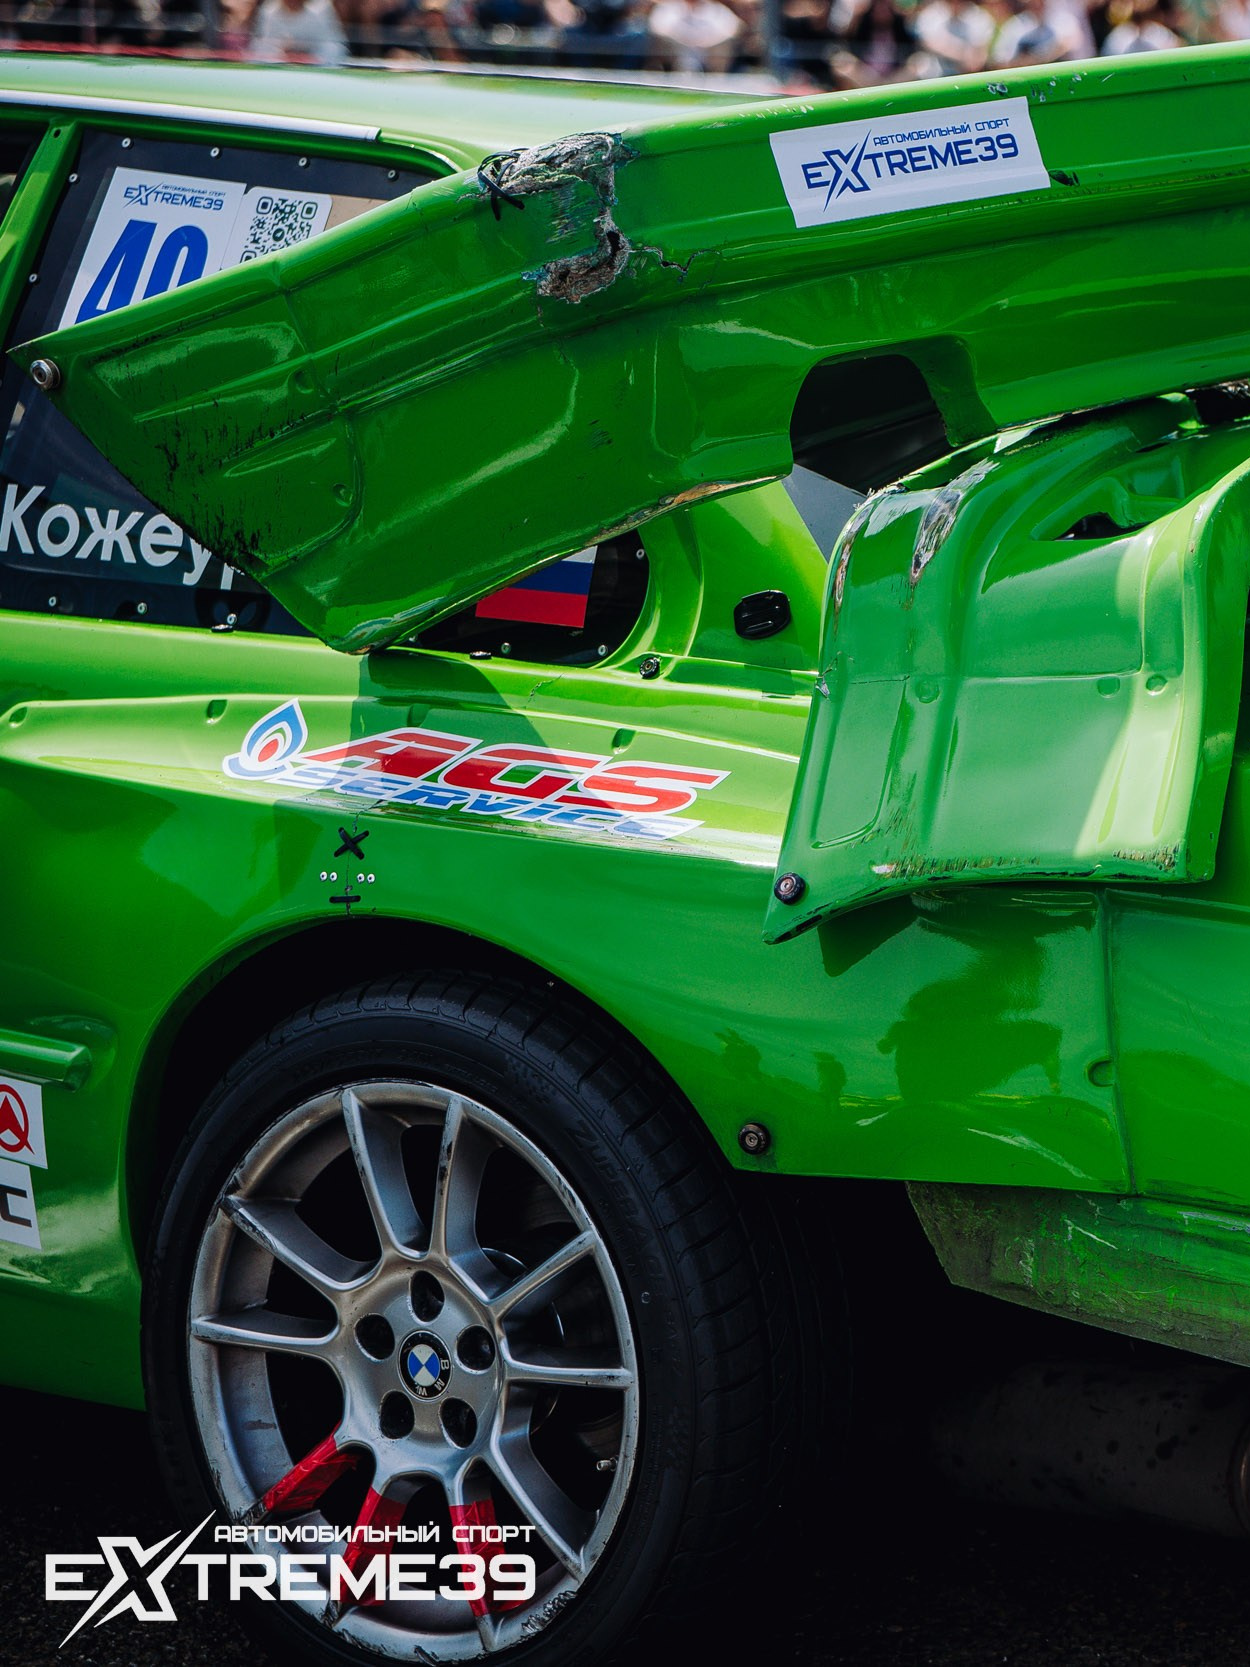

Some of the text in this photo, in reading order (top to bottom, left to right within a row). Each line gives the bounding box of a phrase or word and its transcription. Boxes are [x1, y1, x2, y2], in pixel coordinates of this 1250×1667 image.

[873, 117, 1010, 147] АВТОМОБИЛЬНЫЙ СПОРТ
[277, 767, 693, 839] SERVICE
